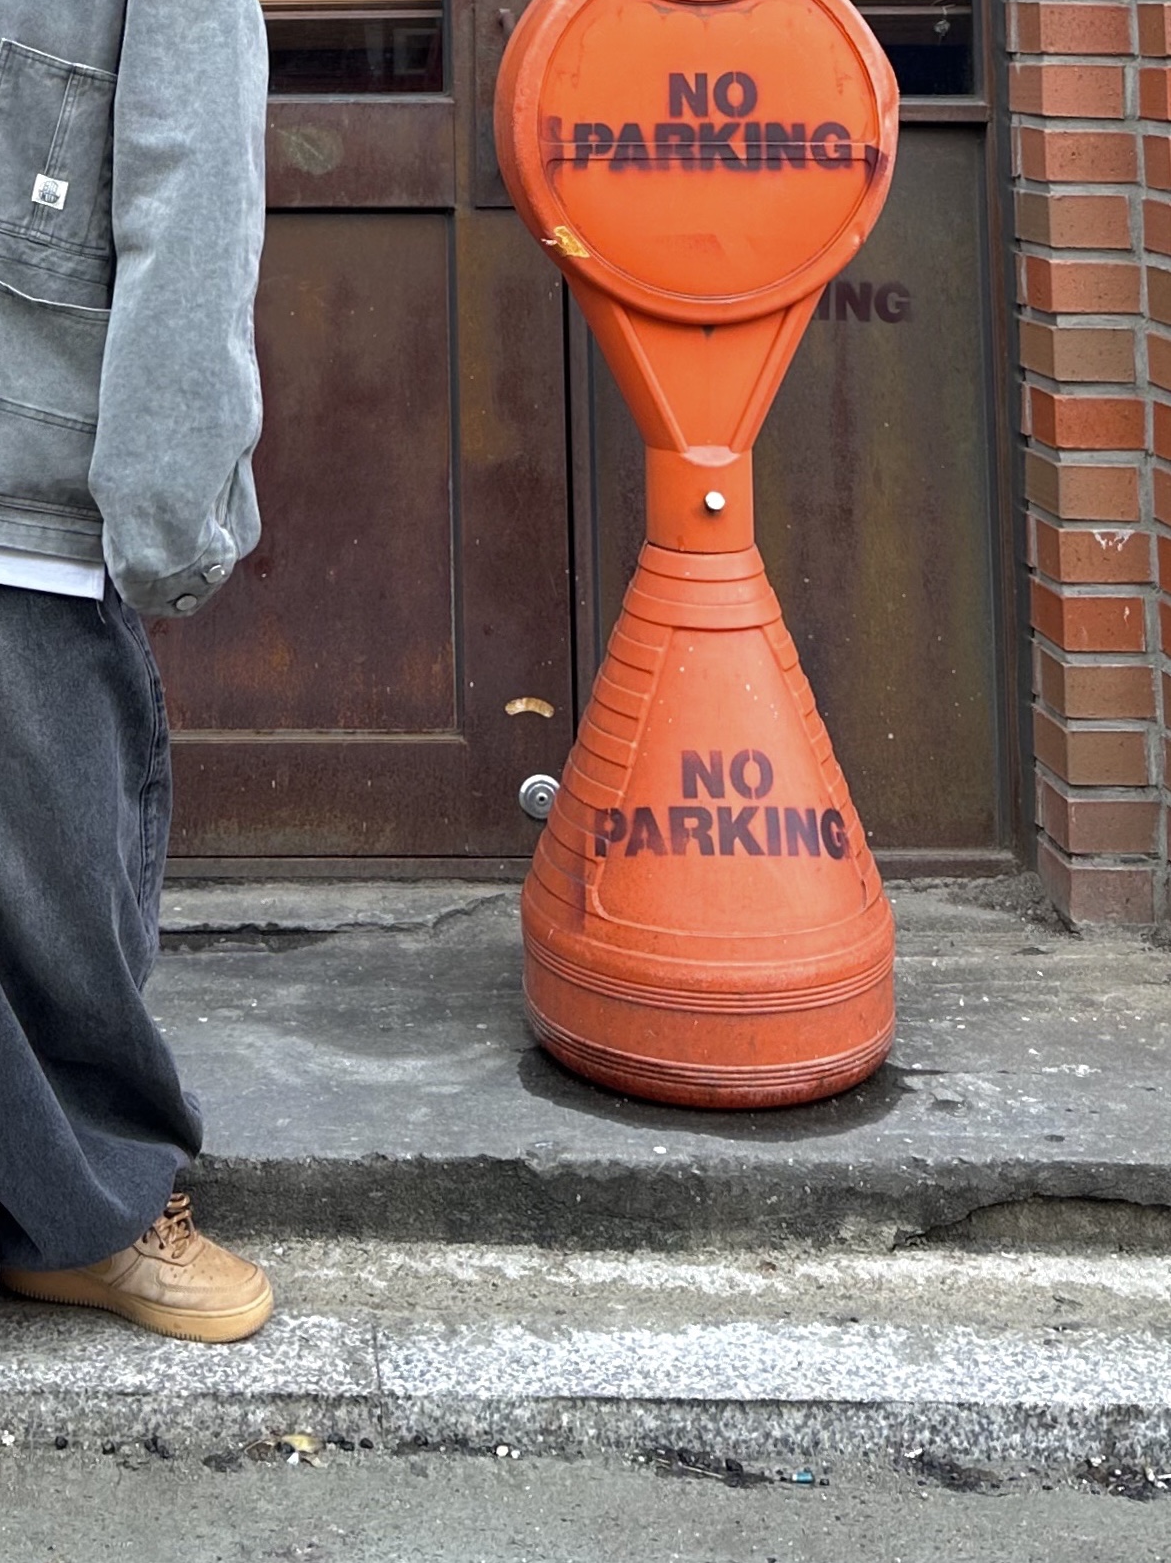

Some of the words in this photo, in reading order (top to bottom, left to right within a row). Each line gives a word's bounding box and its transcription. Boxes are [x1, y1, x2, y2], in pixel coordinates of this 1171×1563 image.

[668, 71, 758, 118] NO
[572, 122, 853, 172] PARKING
[812, 281, 912, 324] ING
[681, 749, 774, 800] NO
[594, 806, 849, 860] PARKING
